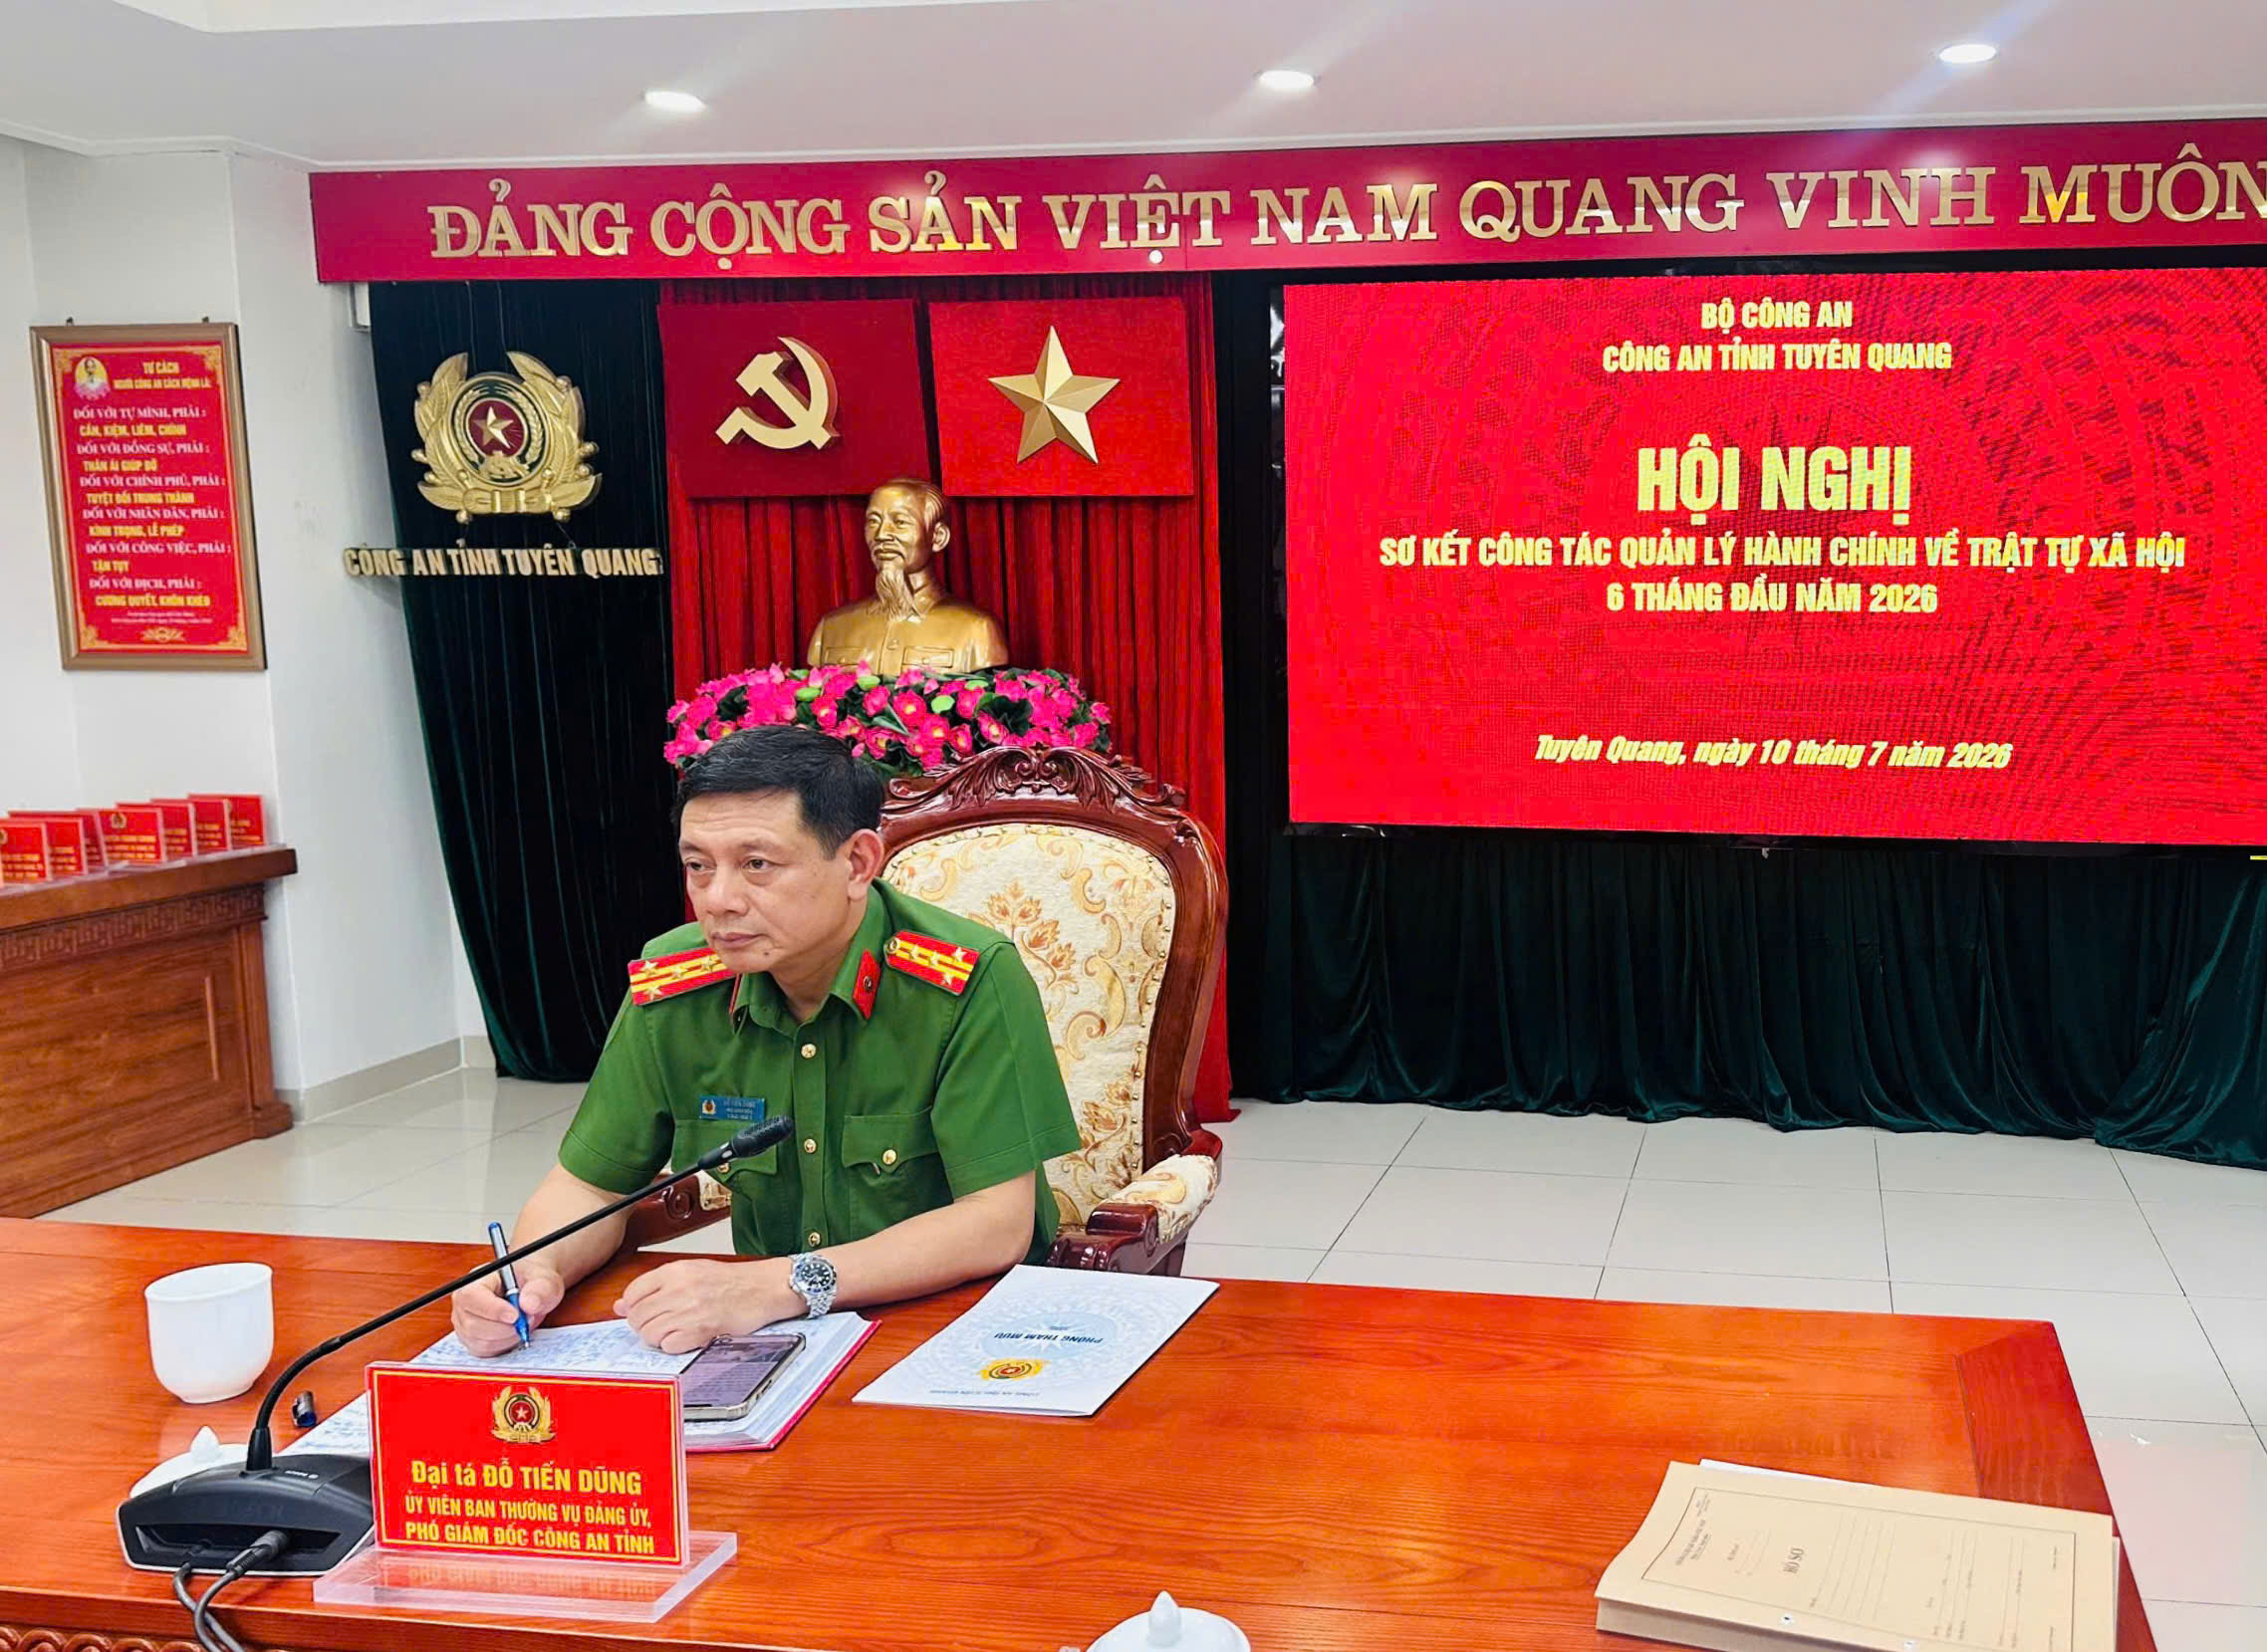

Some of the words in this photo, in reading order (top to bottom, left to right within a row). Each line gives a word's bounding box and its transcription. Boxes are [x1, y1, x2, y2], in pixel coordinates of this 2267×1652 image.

[426, 177, 633, 258] ĐẢNG
[649, 182, 851, 271] CỘNG
[869, 169, 1022, 253] SẢN
[1042, 173, 1231, 265] VIỆT
[1250, 183, 1438, 245] NAM
[1459, 172, 1745, 243] QUANG
[1766, 166, 1995, 230] VINH
[2019, 142, 2267, 223] MUÔN
[1701, 297, 1735, 335] BỘ
[1742, 296, 1810, 329] CÔNG
[1817, 301, 1853, 329] AN
[1603, 341, 1670, 372] CÔNG
[1676, 346, 1712, 371] AN
[1718, 336, 1775, 370] TỈNH
[1782, 338, 1861, 370] TUYÊN
[1868, 343, 1952, 372] QUANG
[74, 404, 94, 419] ĐỐI
[97, 405, 118, 419] VỚI
[77, 441, 98, 454] ĐỐI
[100, 441, 121, 454] VỚI
[80, 473, 100, 486] ĐỐI
[102, 474, 125, 486] VỚI
[1637, 433, 1740, 526] HỘI
[1761, 446, 1911, 526] NGHỊ
[83, 506, 105, 519] ĐỐI
[106, 506, 127, 519] VỚI
[86, 540, 107, 554] ĐỐI
[109, 541, 129, 554] VỚI
[344, 544, 405, 576] CÔNG
[411, 549, 447, 576] AN
[447, 538, 501, 576] TỈNH
[501, 544, 577, 576] TUYÊN
[581, 549, 659, 580] QUANG
[1380, 535, 1416, 567] SƠ
[1423, 529, 1472, 566] KẾT
[1479, 531, 1552, 567] CÔNG
[1560, 531, 1613, 567] TÁC
[1620, 527, 1695, 569] QUẢN
[1704, 531, 1737, 566] LÝ
[1744, 531, 1821, 566] HÀNH
[1829, 531, 1917, 567] CHÍNH
[1924, 527, 1959, 567] VỀ
[1967, 531, 2038, 574] TRẬT
[2045, 535, 2085, 574] TỰ
[2088, 531, 2128, 568] XÃ
[2136, 531, 2185, 574] HỘI
[89, 575, 110, 589] ĐỐI
[112, 577, 132, 589] VỚI
[1607, 582, 1625, 611] 6
[1632, 577, 1723, 611] THÁNG
[1730, 573, 1788, 611] ĐẦU
[1796, 577, 1862, 612] NĂM
[1869, 584, 1938, 613] 2026
[1535, 735, 1602, 763] Tuyên
[1605, 736, 1687, 766] Quang,
[1693, 738, 1757, 768] ngày
[1760, 739, 1790, 765] 10
[1793, 739, 1864, 769] tháng
[1867, 741, 1889, 767] 7
[1889, 741, 1944, 768] năm
[1946, 742, 2013, 769] 2026
[411, 1460, 448, 1489] Đại
[454, 1462, 477, 1487] tá
[483, 1457, 514, 1489] ĐỖ
[520, 1461, 571, 1492] TIẾN
[578, 1466, 642, 1496] DŨNG
[405, 1489, 423, 1514] ỦY
[427, 1494, 461, 1517] VIÊN
[464, 1499, 496, 1519] BAN
[500, 1498, 558, 1522] THƯỜNG
[562, 1504, 581, 1527] VỤ
[585, 1501, 626, 1527] ĐẢNG
[630, 1502, 651, 1529] ỦY,
[405, 1520, 439, 1541] PHÓ
[444, 1521, 489, 1543] GIÁM
[493, 1523, 529, 1545] ĐỐC
[533, 1528, 581, 1549] CÔNG
[586, 1533, 610, 1551] AN
[614, 1529, 654, 1553] TỈNH
